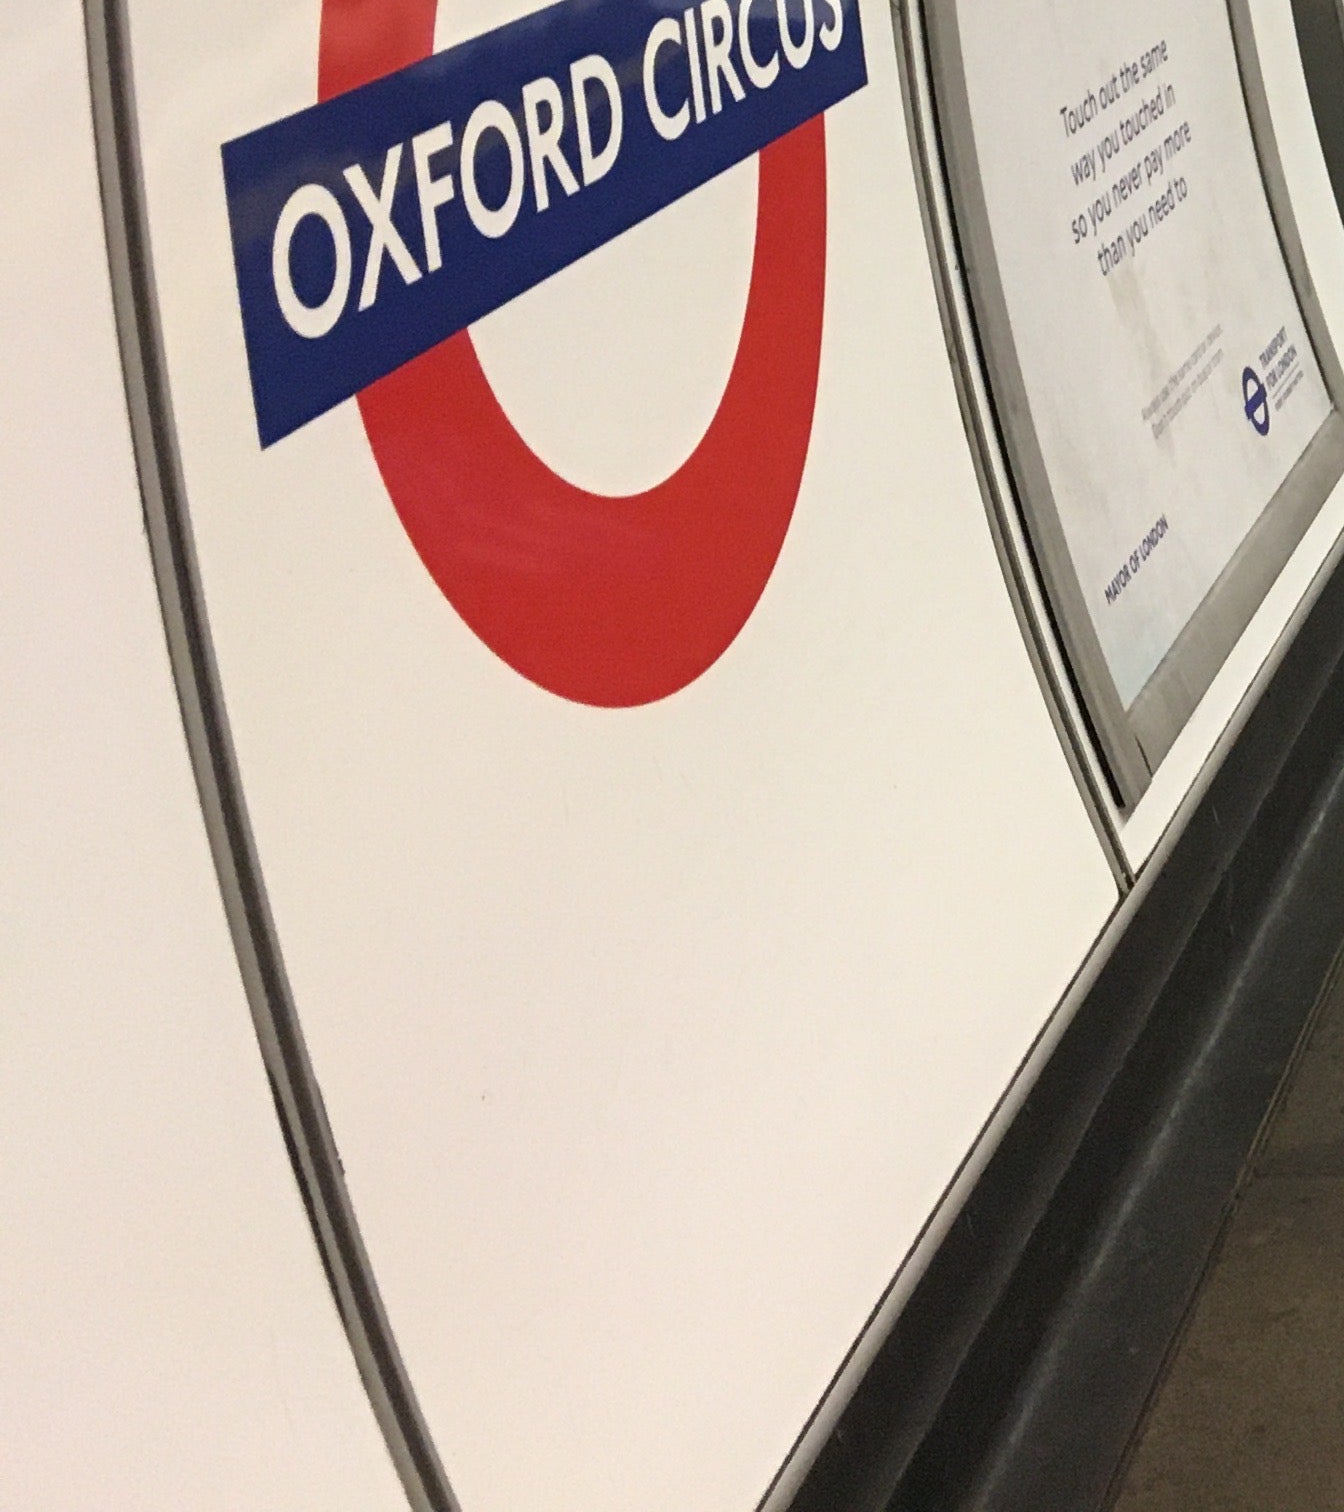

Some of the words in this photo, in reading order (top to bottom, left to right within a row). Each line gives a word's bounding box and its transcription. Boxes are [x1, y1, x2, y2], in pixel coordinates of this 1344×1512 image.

[1060, 89, 1097, 137] Touch
[1099, 74, 1120, 110] out
[1119, 62, 1139, 92] the
[1140, 40, 1168, 78] same
[1071, 148, 1096, 186] way
[1097, 131, 1120, 173] you
[1119, 86, 1164, 146] touched
[1163, 83, 1176, 109] in
[272, 54, 623, 338] OXFORD
[1071, 214, 1087, 244] so
[1088, 195, 1112, 237] you
[1111, 159, 1142, 208] never
[1144, 145, 1163, 186] pay
[1163, 121, 1192, 160] more
[1097, 234, 1126, 276] than
[1126, 213, 1149, 257] you
[1148, 180, 1175, 228] need
[1173, 176, 1188, 202] to
[1105, 564, 1132, 605] MAYOR
[1129, 549, 1140, 574] OF
[1139, 513, 1169, 562] LONDON
